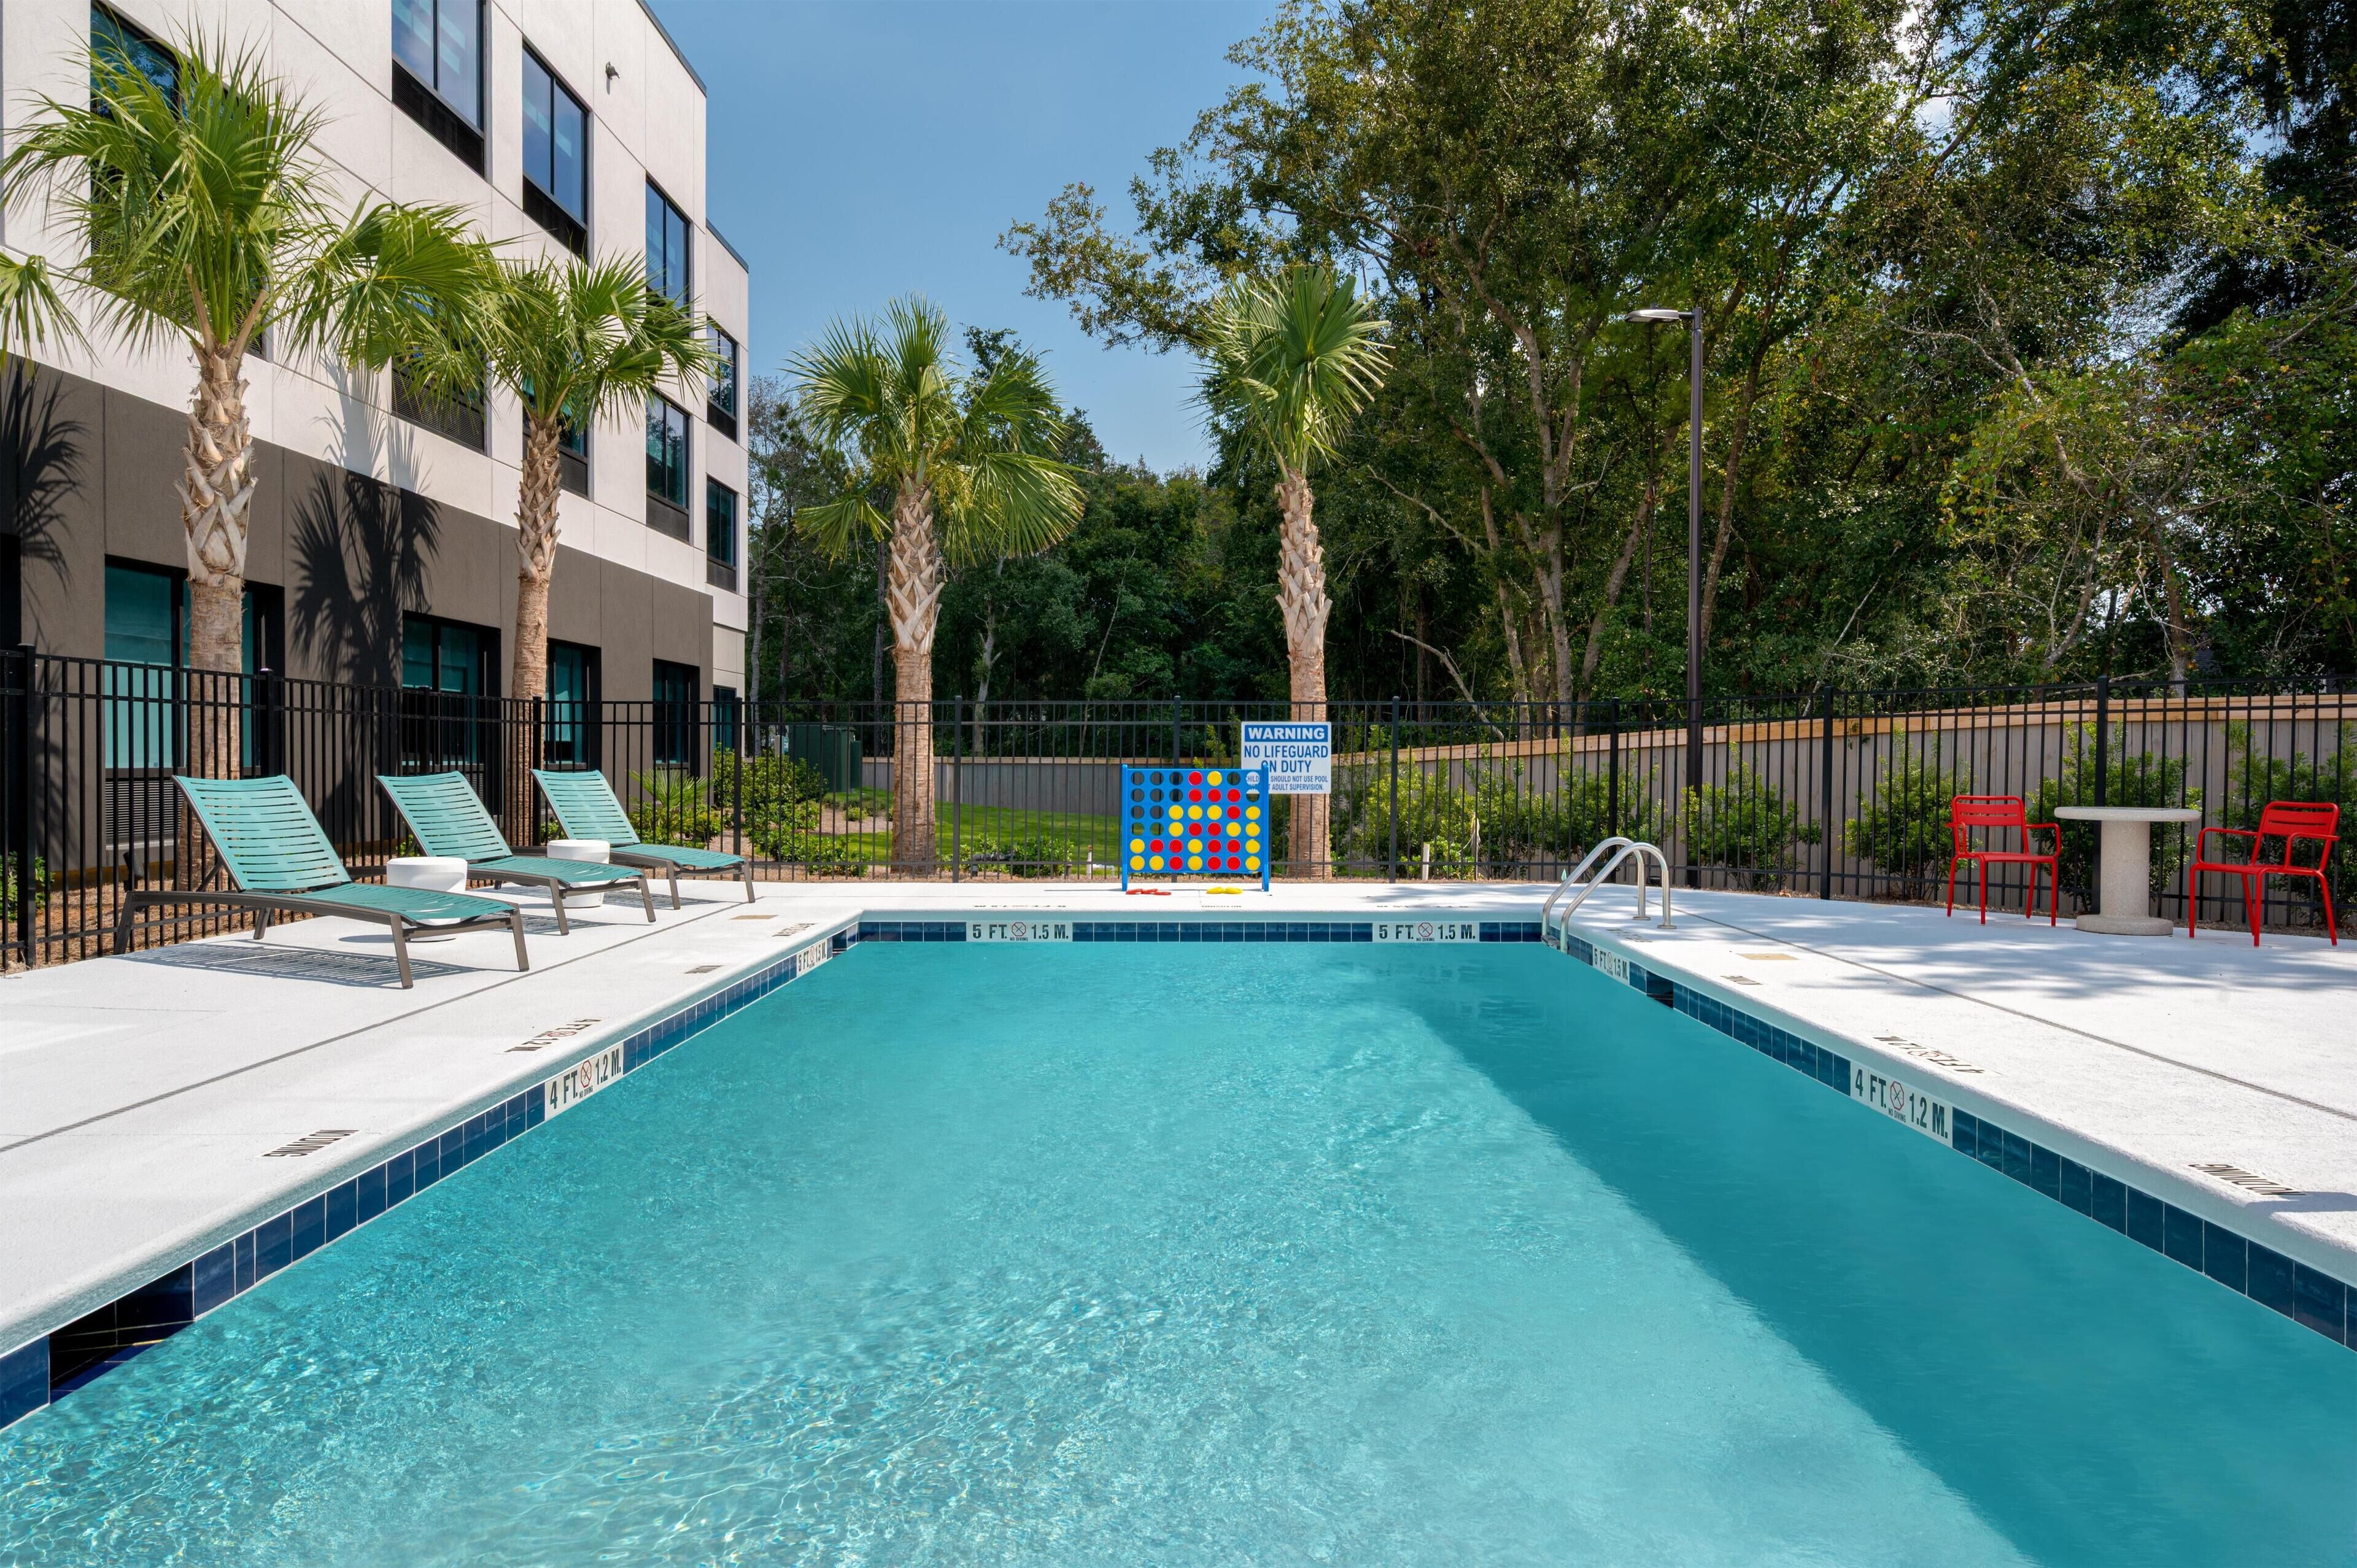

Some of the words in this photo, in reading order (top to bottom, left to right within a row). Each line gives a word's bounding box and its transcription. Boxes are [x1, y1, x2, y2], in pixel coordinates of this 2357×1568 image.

[1248, 727, 1325, 740] WARNING
[1244, 745, 1260, 758] NO
[1264, 745, 1328, 758] LIFEGUARD
[1281, 760, 1312, 773] DUTY
[972, 924, 981, 938] 5
[989, 924, 1007, 939] FT.
[1031, 924, 1049, 939] 1.5
[1054, 924, 1069, 939] M.
[1379, 924, 1388, 939] 5
[1395, 924, 1414, 939] FT.
[1438, 924, 1455, 939] 1.5
[1461, 924, 1476, 939] M.
[799, 954, 802, 971] 5
[1594, 948, 1598, 965] 5
[550, 1081, 557, 1110] 4
[563, 1070, 578, 1104] FT.
[595, 1054, 608, 1085] 1.2
[611, 1048, 621, 1077] M.
[1855, 1069, 1864, 1097] 4
[1870, 1074, 1887, 1109] FT.
[1909, 1093, 1927, 1129] 1.2
[1932, 1102, 1948, 1139] M.
[1888, 1108, 1894, 1116] NO
[1894, 1111, 1906, 1123] DIVING
